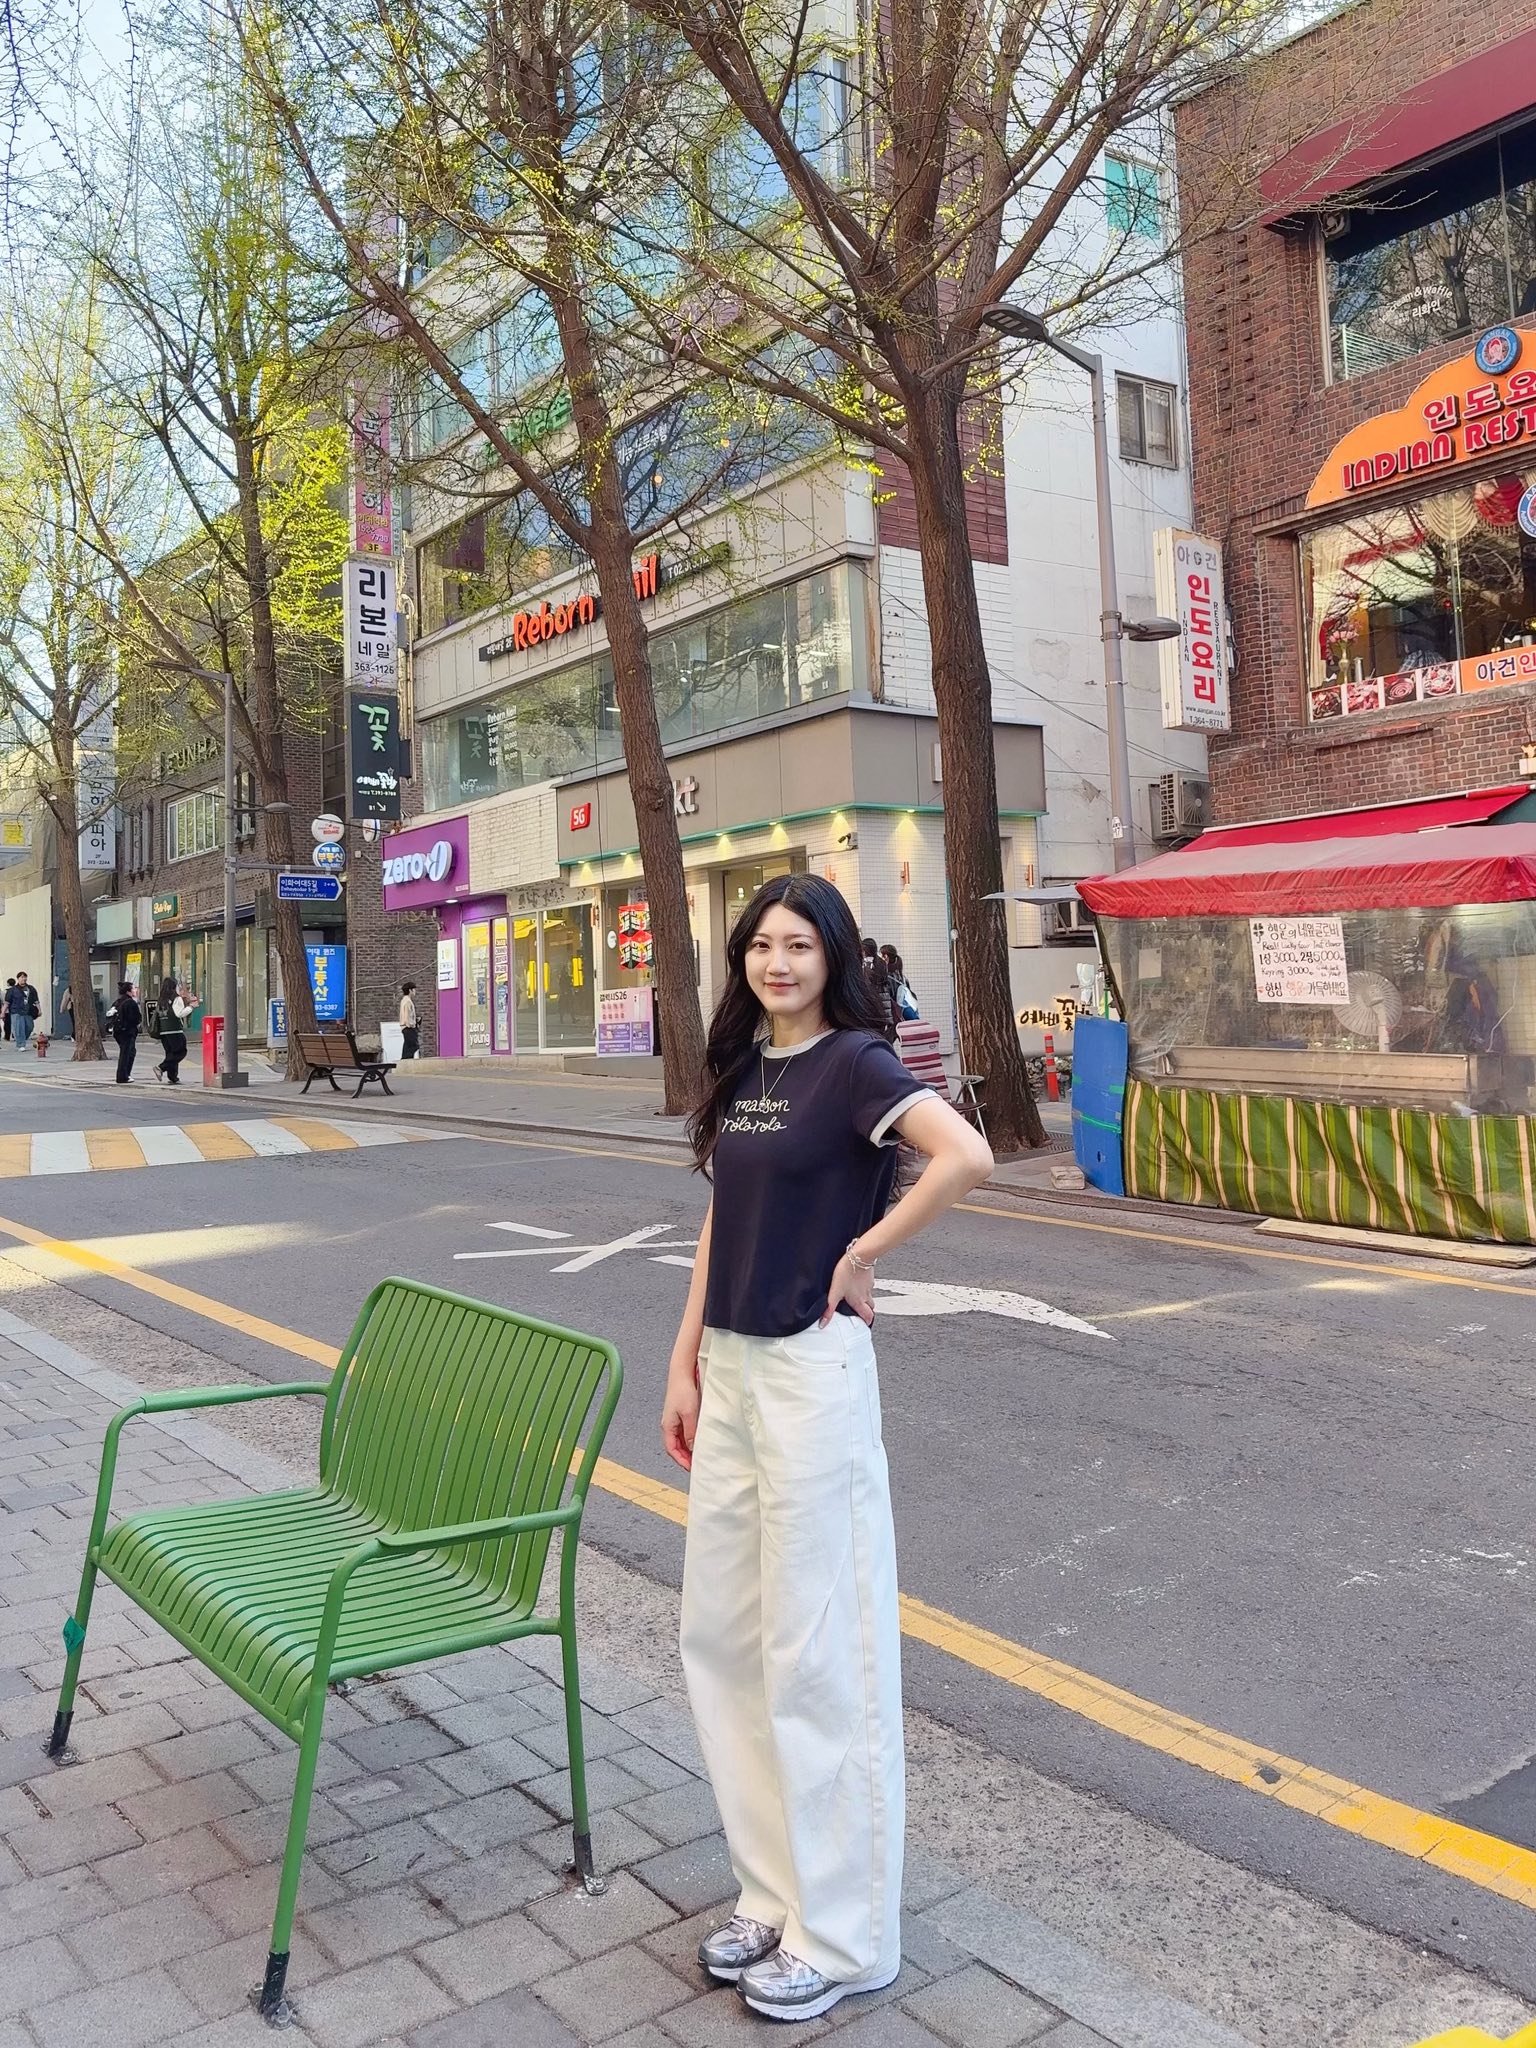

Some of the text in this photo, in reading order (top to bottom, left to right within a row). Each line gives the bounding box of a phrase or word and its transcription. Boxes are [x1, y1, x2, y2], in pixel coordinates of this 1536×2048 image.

[1412, 299, 1441, 317] 리화인
[1342, 432, 1452, 490] INDIAN
[368, 543, 379, 552] 3F
[359, 568, 387, 636] 리본
[513, 594, 594, 652] Reborn
[1182, 611, 1190, 662] INDIAN
[1187, 574, 1216, 704] 인도요리
[1213, 601, 1223, 687] RESTAURANT
[358, 641, 389, 658] 네일
[354, 662, 395, 674] 363-1126
[358, 704, 389, 752] 꽃
[673, 776, 698, 816] kt
[573, 808, 585, 826] 5G
[281, 879, 318, 887] 이화여대5길
[1268, 922, 1339, 940] 행운의 네잎클로버
[313, 956, 329, 1001] 부동산
[1265, 981, 1283, 998] 항상
[469, 1021, 485, 1033] zero
[469, 1033, 490, 1046] young
[735, 1098, 790, 1114] maison
